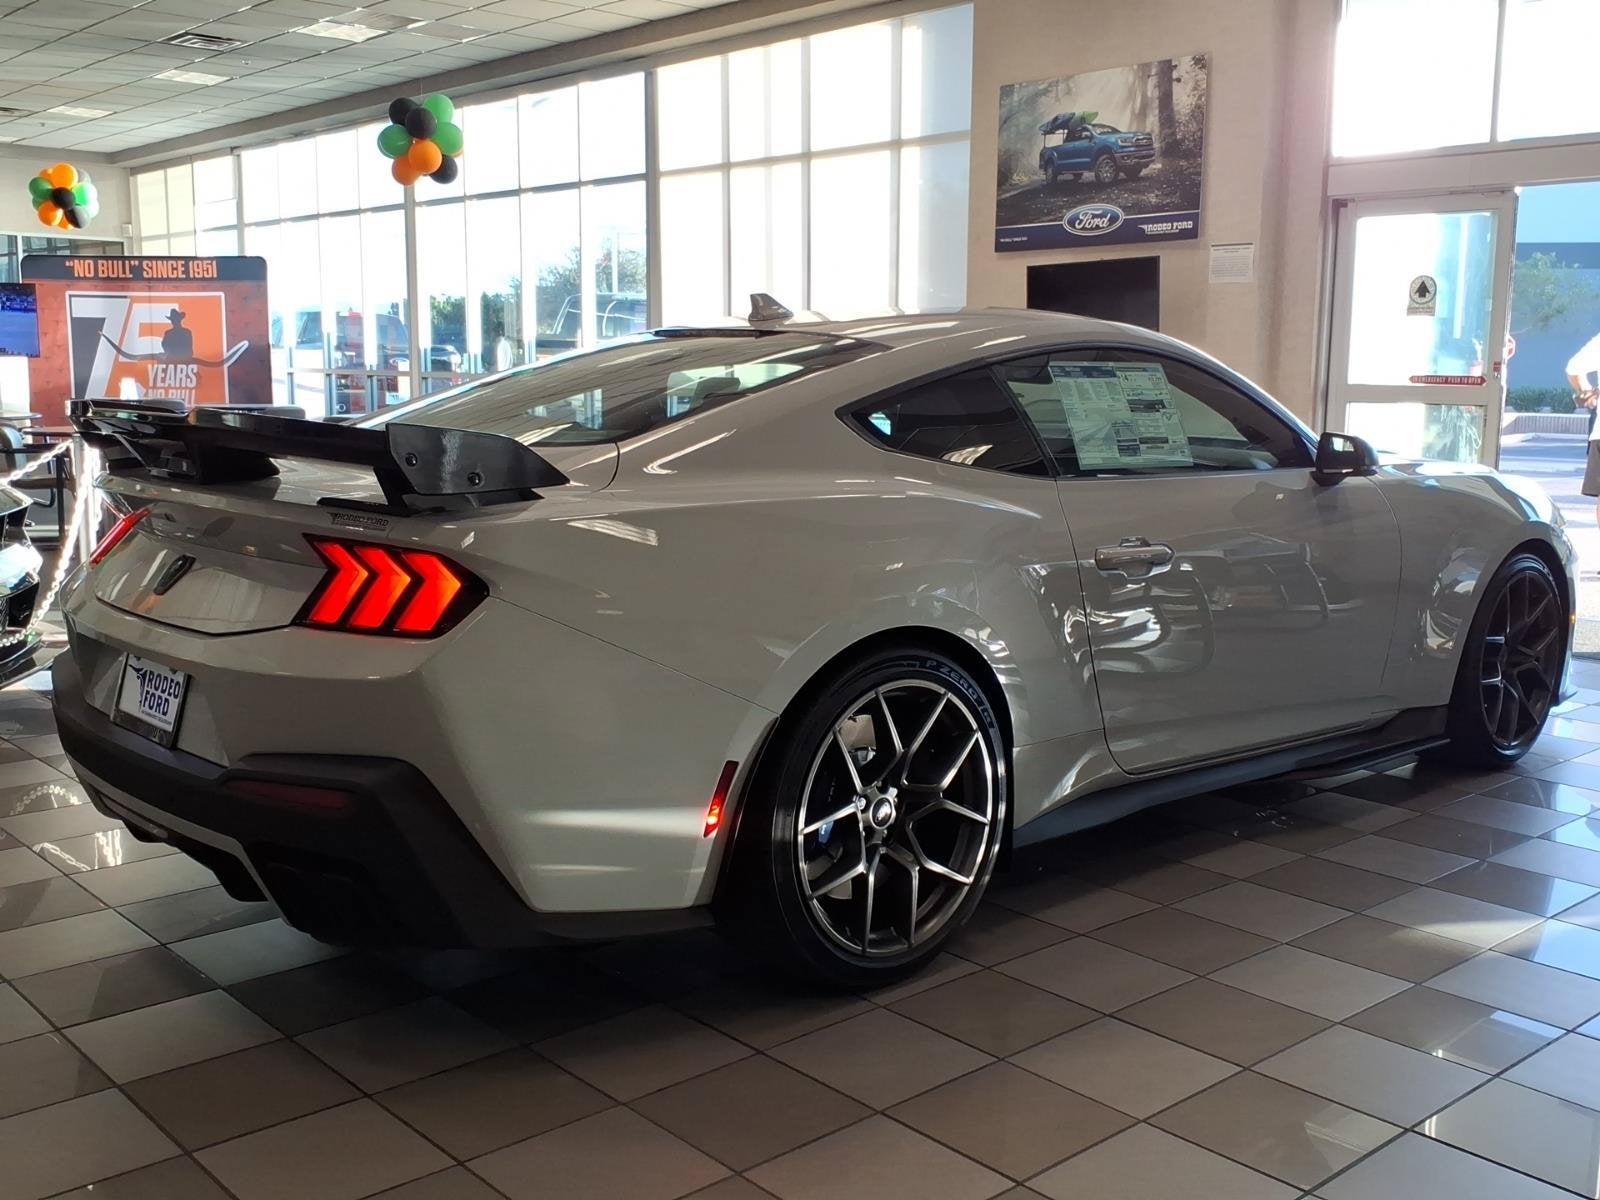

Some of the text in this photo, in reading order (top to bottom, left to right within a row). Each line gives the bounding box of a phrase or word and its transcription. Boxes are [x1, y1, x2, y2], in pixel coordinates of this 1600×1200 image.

[1075, 210, 1111, 229] Ford
[1173, 221, 1193, 230] FORD
[142, 259, 186, 278] SINCE
[189, 259, 218, 278] 1951
[147, 363, 198, 388] YEARS
[146, 670, 181, 699] RODEO
[926, 660, 978, 700] P ZERO
[143, 689, 170, 716] FORD
